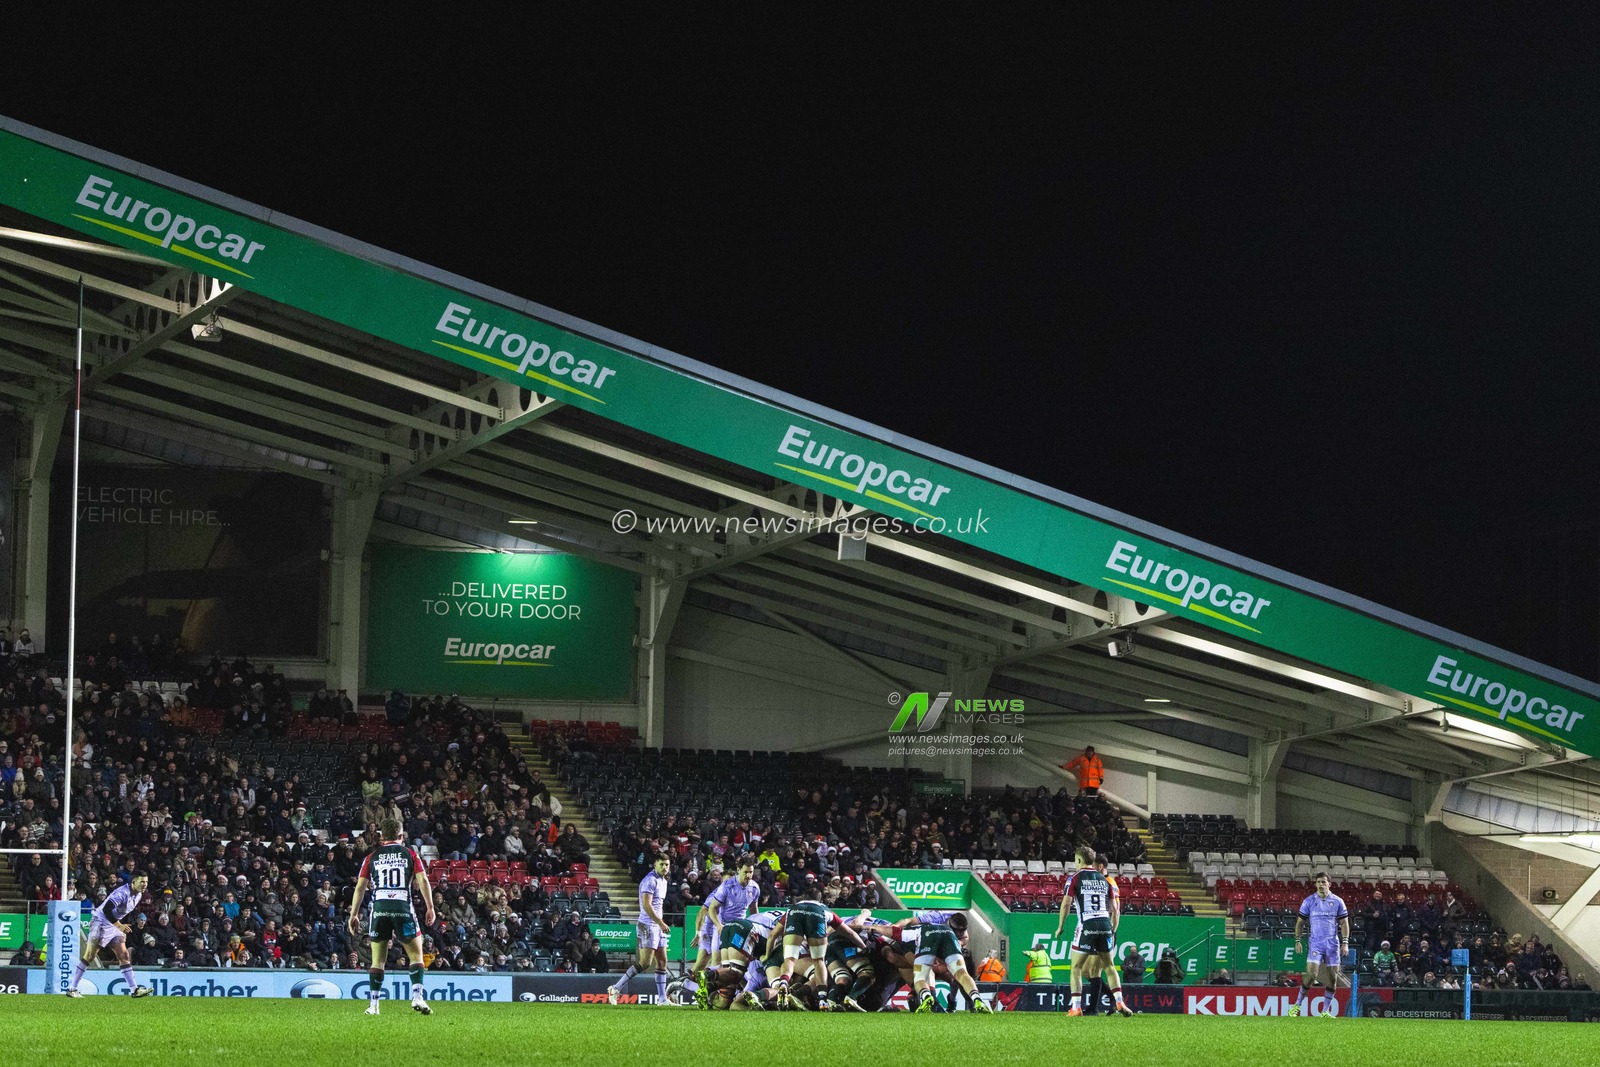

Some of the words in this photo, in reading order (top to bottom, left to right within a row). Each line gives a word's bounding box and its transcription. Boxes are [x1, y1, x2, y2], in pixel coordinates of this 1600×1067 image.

[75, 174, 265, 264] Europcar
[435, 301, 616, 389] Europcar
[777, 424, 950, 506] Europcar
[170, 510, 230, 526] HIRE...
[1106, 541, 1271, 619] Europcar
[438, 581, 566, 600] ...DELIVERED
[422, 600, 450, 615] TO
[455, 601, 513, 617] YOUR
[519, 603, 581, 620] DOOR
[444, 637, 555, 664] Europcar
[1427, 655, 1584, 731] Europcar
[382, 868, 401, 888] 10
[884, 877, 963, 899] Europcar
[1091, 894, 1100, 911] 9
[595, 929, 632, 939] Europcar
[59, 924, 74, 992] Gallagher
[1216, 946, 1228, 959] E
[1248, 946, 1259, 960] E
[1284, 947, 1295, 961] E
[1187, 958, 1198, 972] E
[538, 994, 579, 1003] Gallagher
[1187, 995, 1339, 1017] KUMHO
